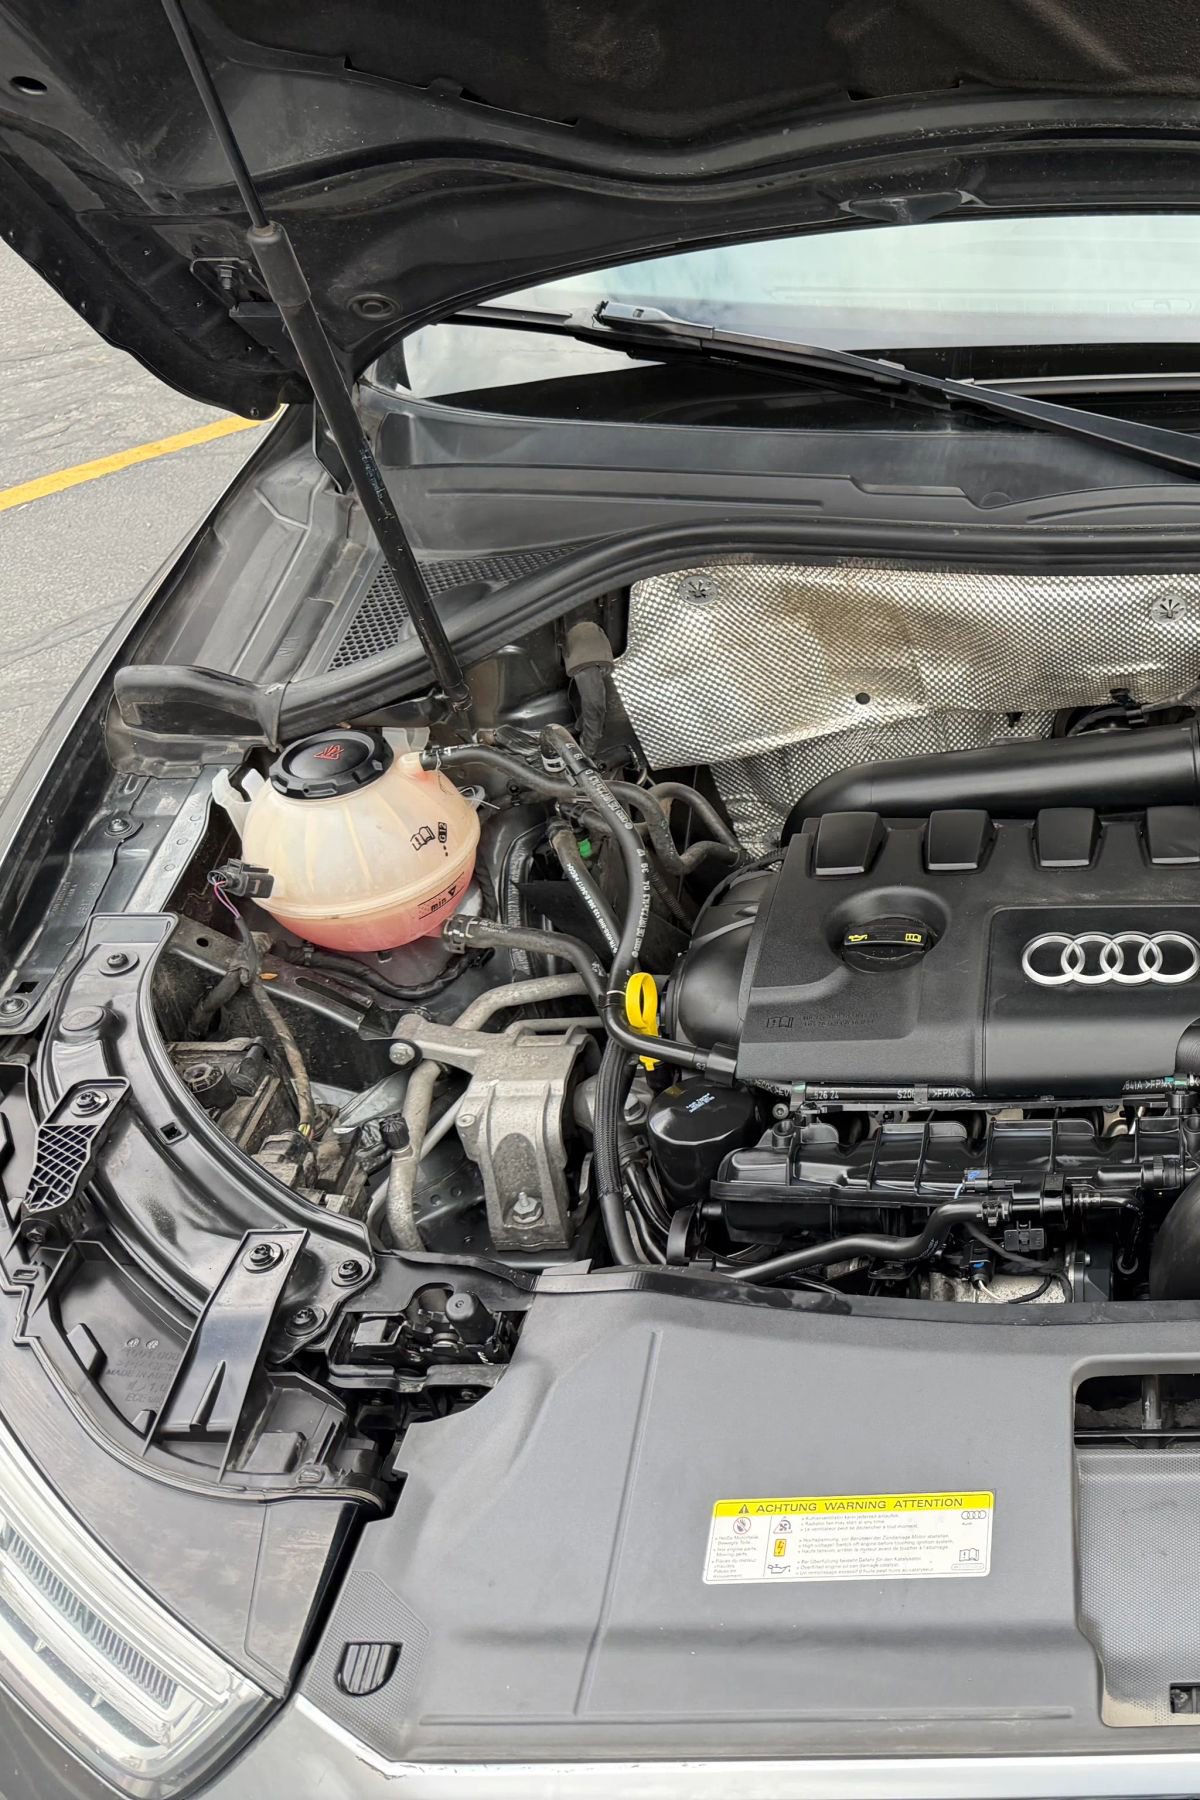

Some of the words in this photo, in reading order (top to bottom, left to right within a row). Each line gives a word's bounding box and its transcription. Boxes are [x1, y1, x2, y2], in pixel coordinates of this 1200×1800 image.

[430, 897, 447, 912] min
[756, 1503, 817, 1513] ACHTUNG
[824, 1501, 886, 1511] WARNING
[893, 1498, 963, 1508] ATTENTION
